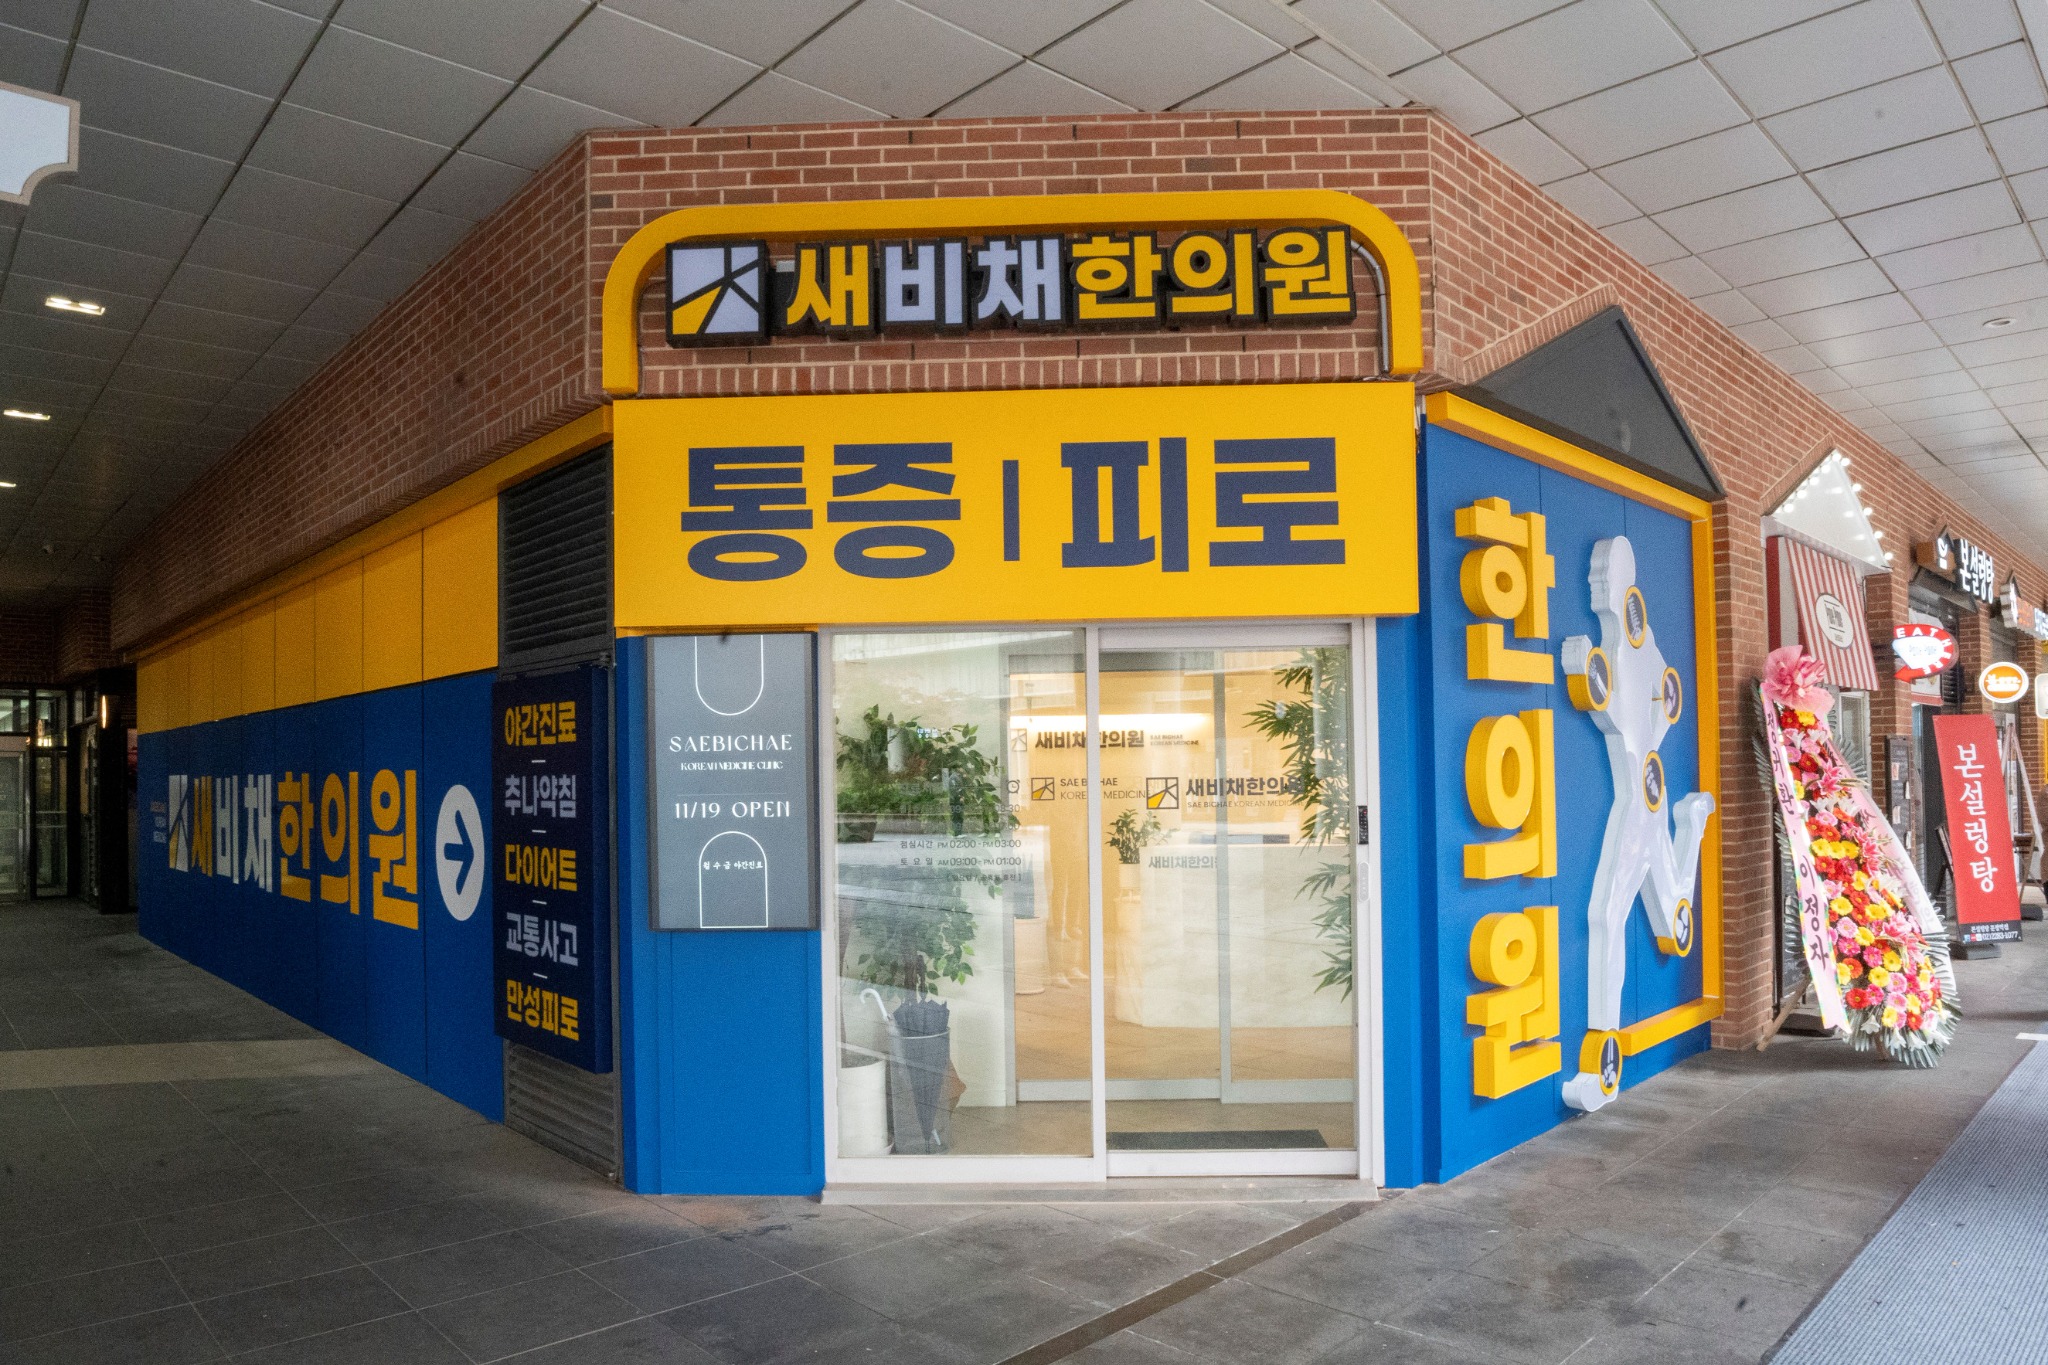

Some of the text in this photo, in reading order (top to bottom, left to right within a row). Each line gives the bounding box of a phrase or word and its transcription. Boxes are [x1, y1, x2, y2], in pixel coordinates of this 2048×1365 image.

[786, 229, 1351, 327] 새비채한의원
[681, 437, 1346, 582] 통증 피로
[1960, 538, 1994, 604] 본설렁탕
[1896, 627, 1938, 638] EAT
[505, 701, 576, 746] 야간진료
[669, 734, 792, 752] SAEBICHAE
[505, 775, 576, 818] 추나약침
[1060, 778, 1118, 786] SAE BHAE
[1060, 791, 1087, 800] KORE
[1455, 497, 1562, 1099] 한의원
[675, 801, 790, 819] 11/19 OPEN
[1953, 743, 1998, 893] 본설렁탕
[191, 769, 419, 930] 새비채한의원
[505, 844, 577, 891] 다이어트
[900, 840, 933, 849] 점심시간
[949, 840, 977, 848] 02:00
[994, 840, 1021, 848] 03:00
[995, 857, 1022, 865] 01:00
[506, 912, 578, 966] 교통사고
[507, 979, 579, 1041] 만성피로
